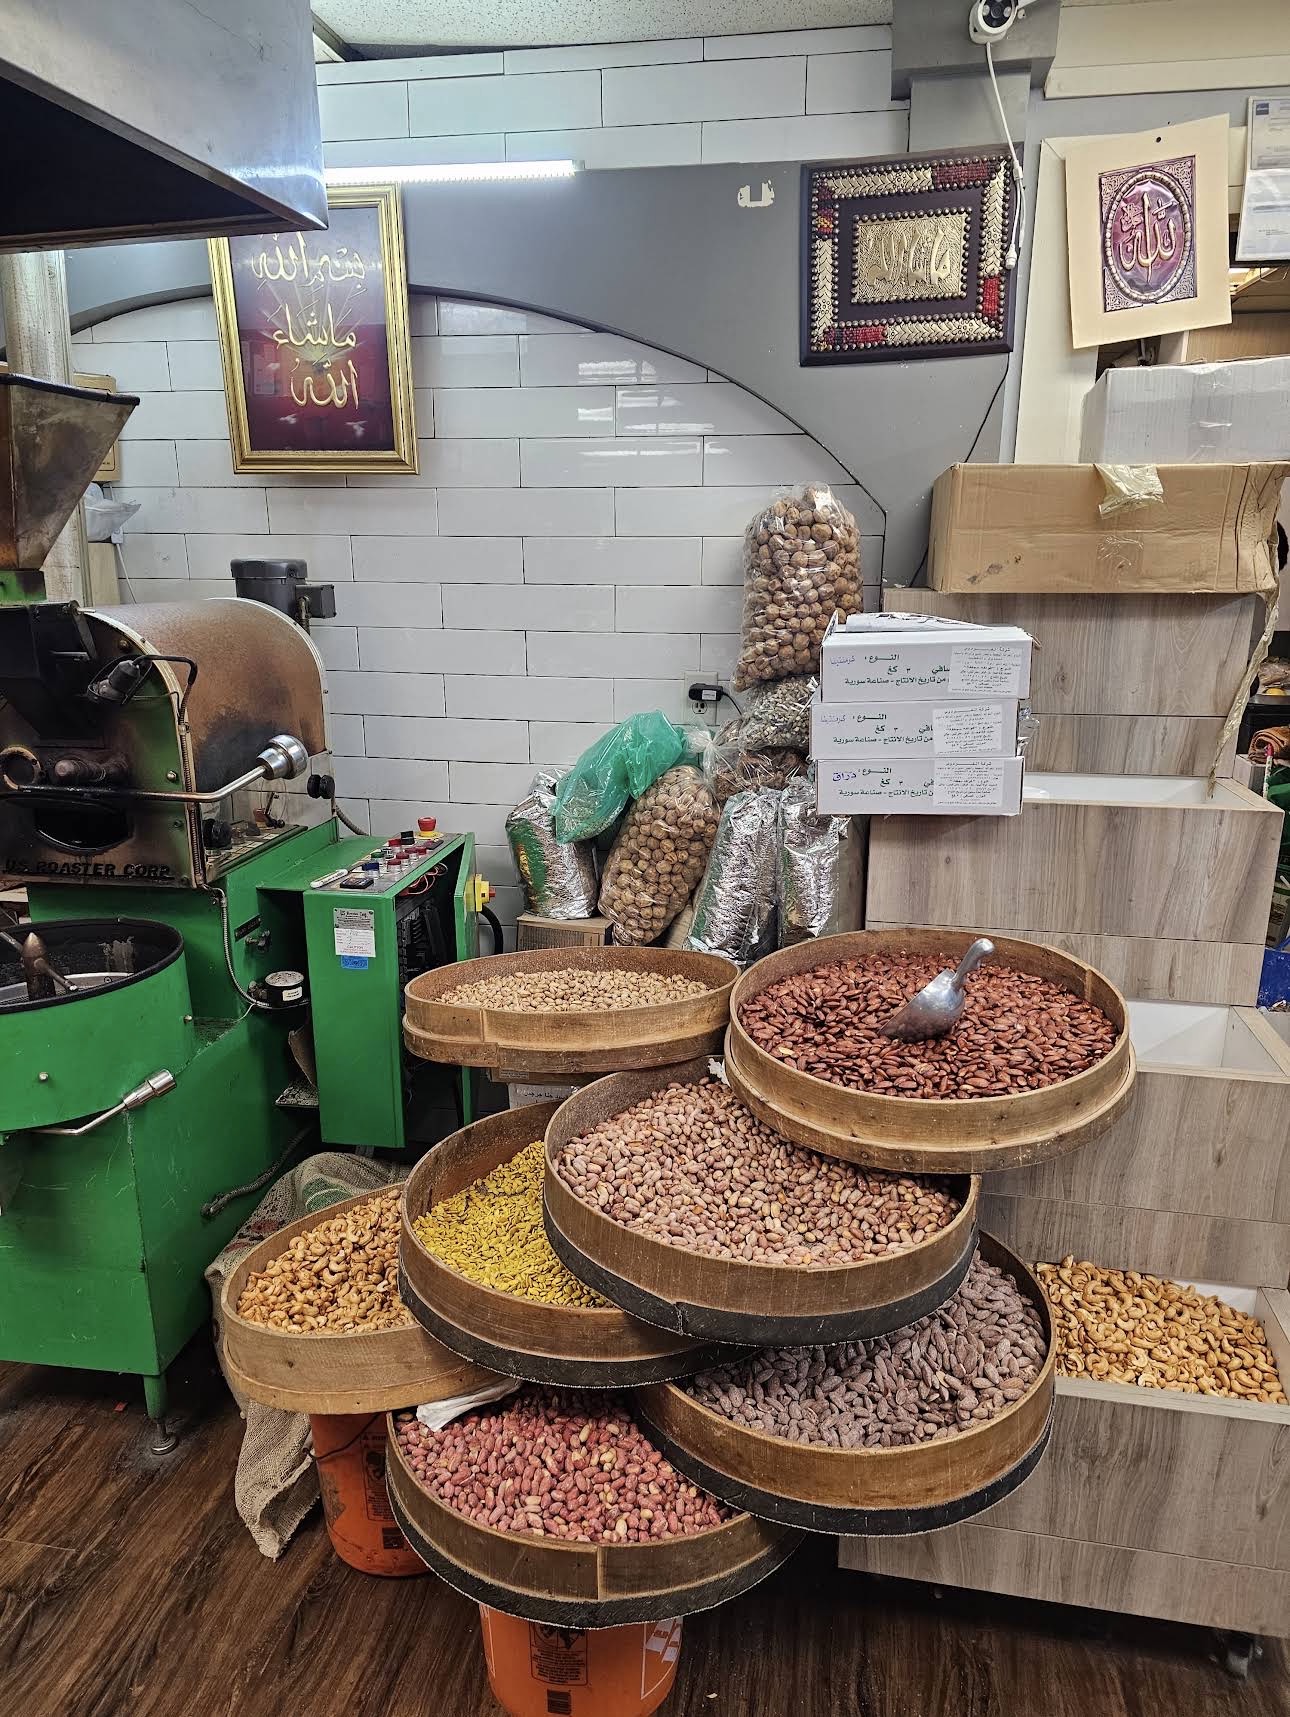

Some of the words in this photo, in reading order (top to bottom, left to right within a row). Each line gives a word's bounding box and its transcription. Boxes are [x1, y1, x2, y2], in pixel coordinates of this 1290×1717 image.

[251, 231, 310, 291] الله
[289, 358, 360, 411] الله
[931, 665, 951, 675] افي
[37, 861, 116, 876] ROASTER
